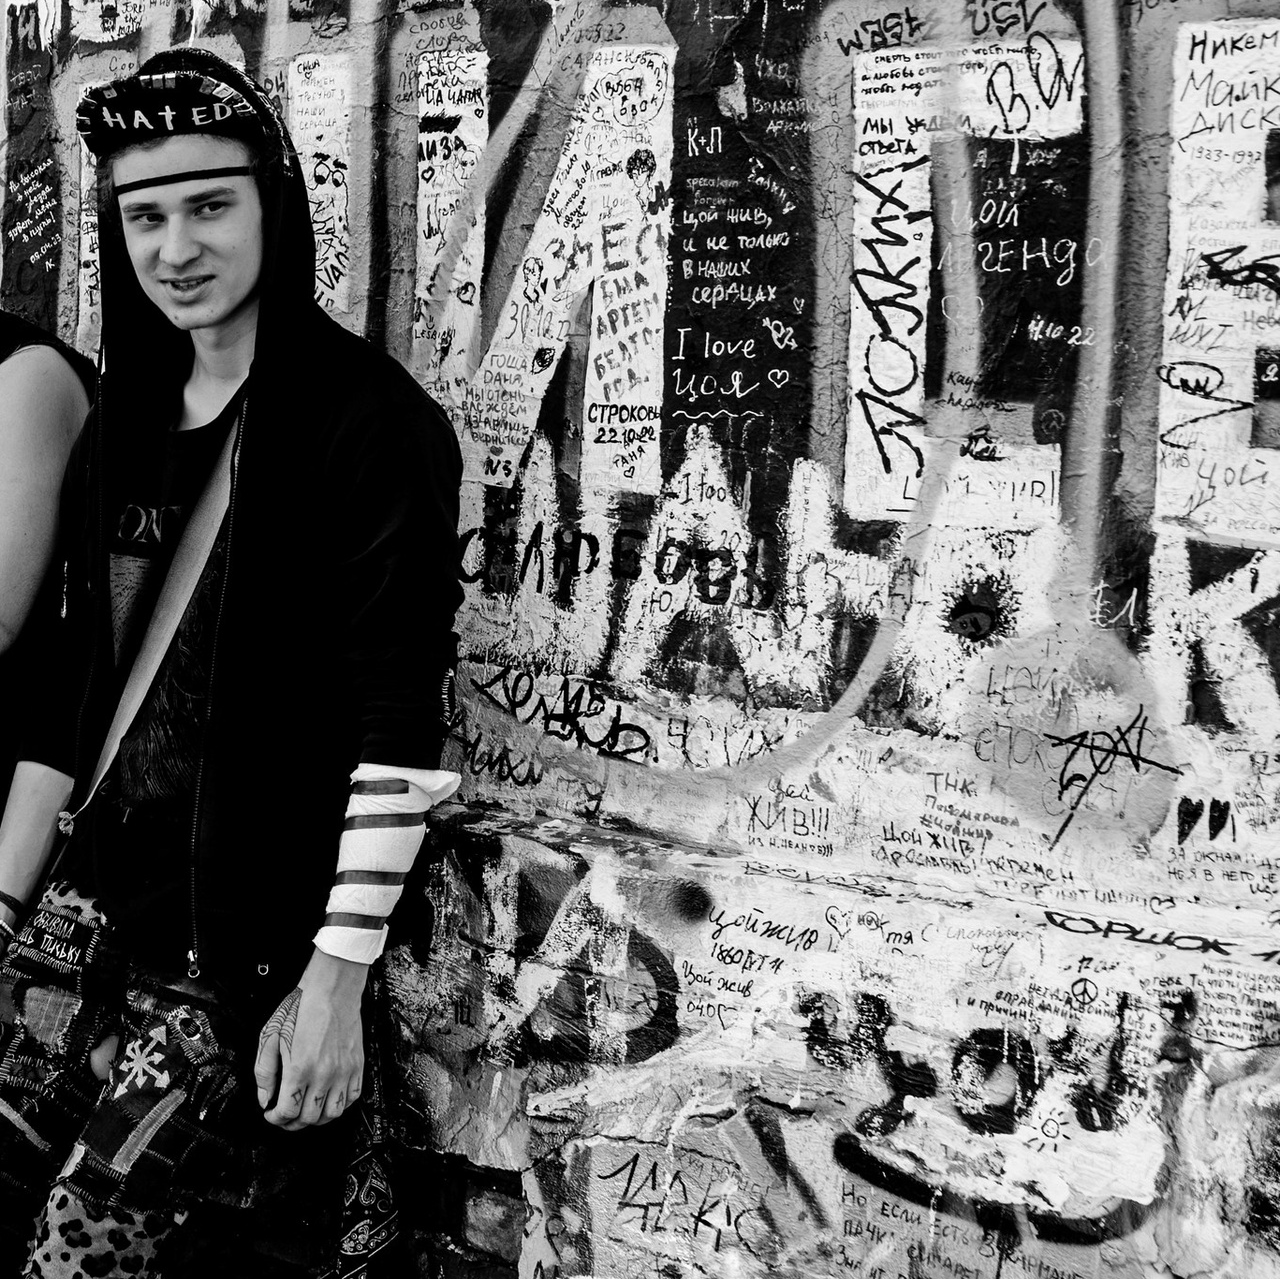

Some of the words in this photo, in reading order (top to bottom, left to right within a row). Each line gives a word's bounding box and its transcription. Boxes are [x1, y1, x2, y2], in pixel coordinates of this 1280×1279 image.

[862, 117, 894, 136] МЫ
[672, 327, 693, 361] I
[704, 326, 757, 360] love
[699, 472, 727, 502] too
